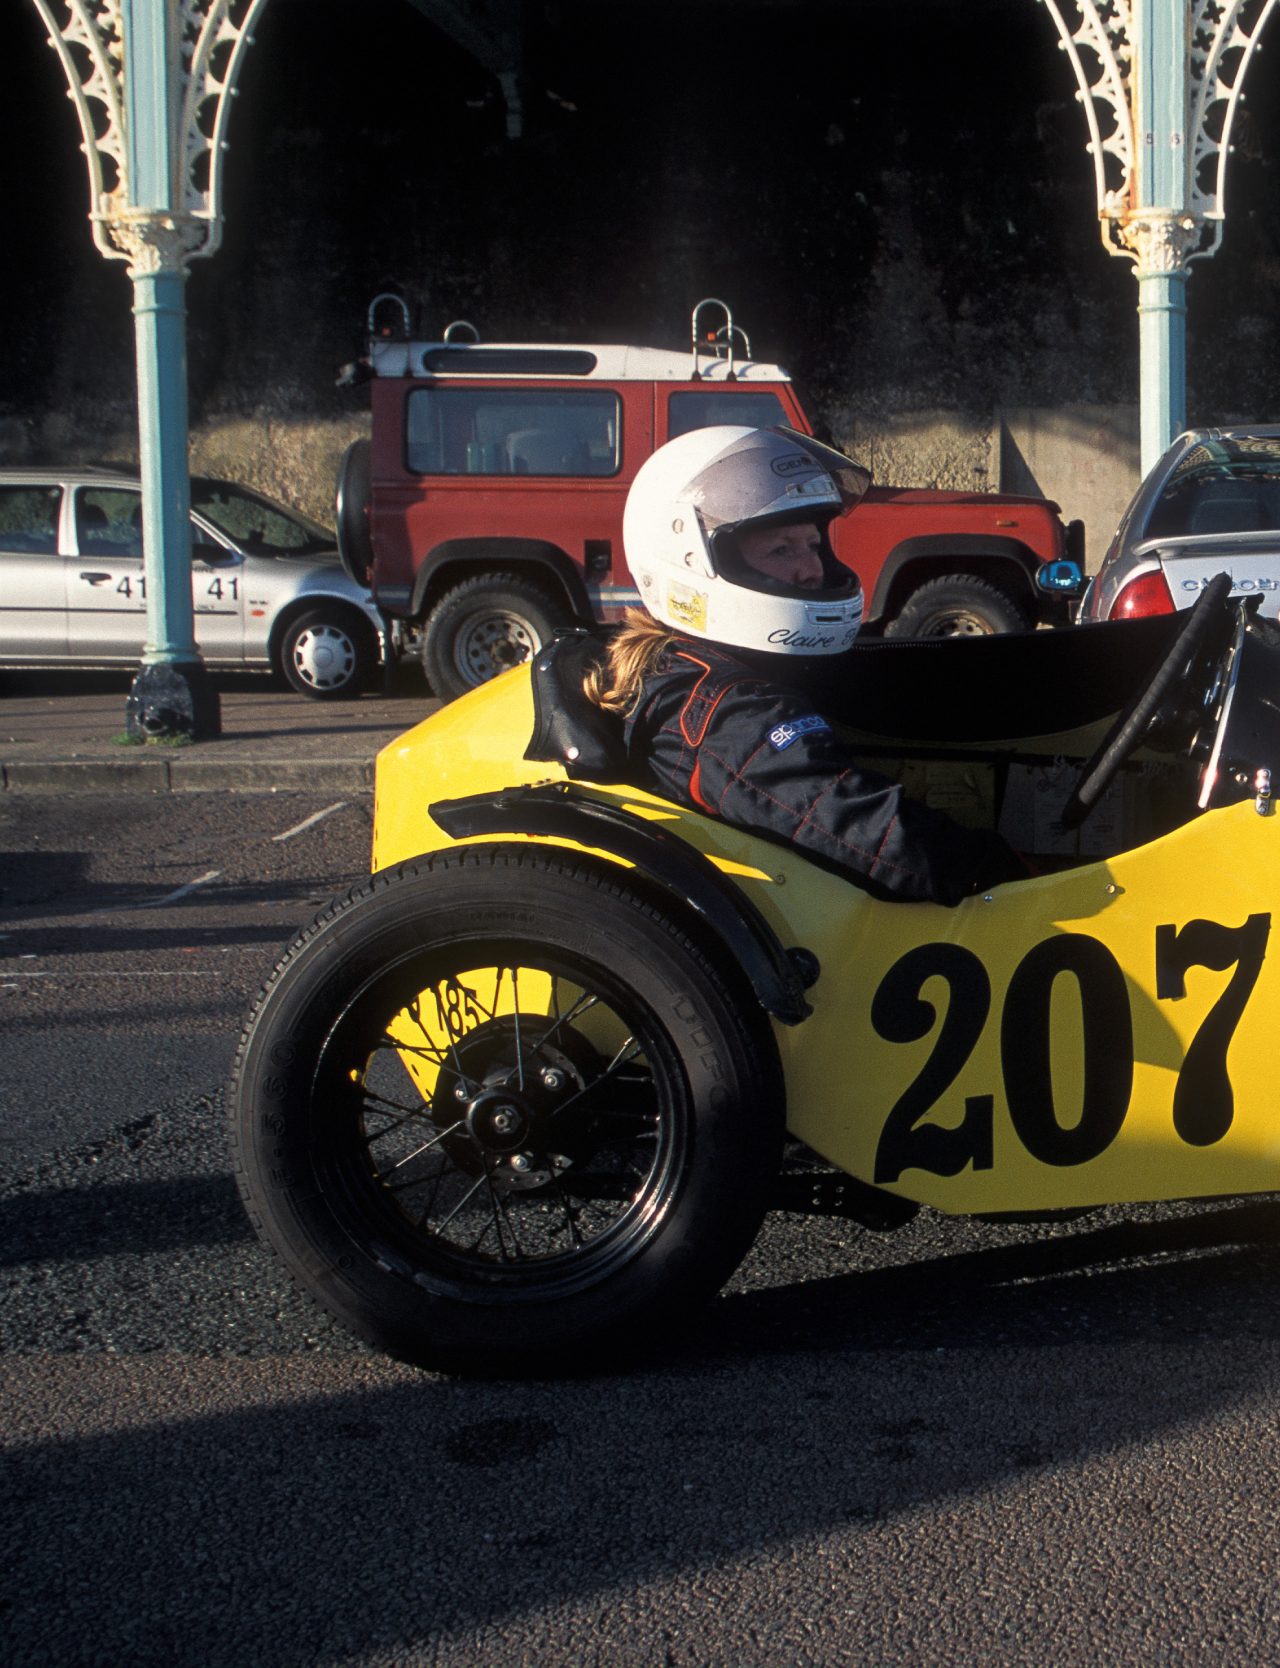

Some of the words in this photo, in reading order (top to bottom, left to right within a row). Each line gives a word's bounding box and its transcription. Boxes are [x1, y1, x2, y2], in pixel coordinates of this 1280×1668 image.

[116, 576, 146, 599] 41
[207, 577, 238, 600] 41
[767, 628, 835, 649] Claire
[871, 911, 1272, 1187] 207
